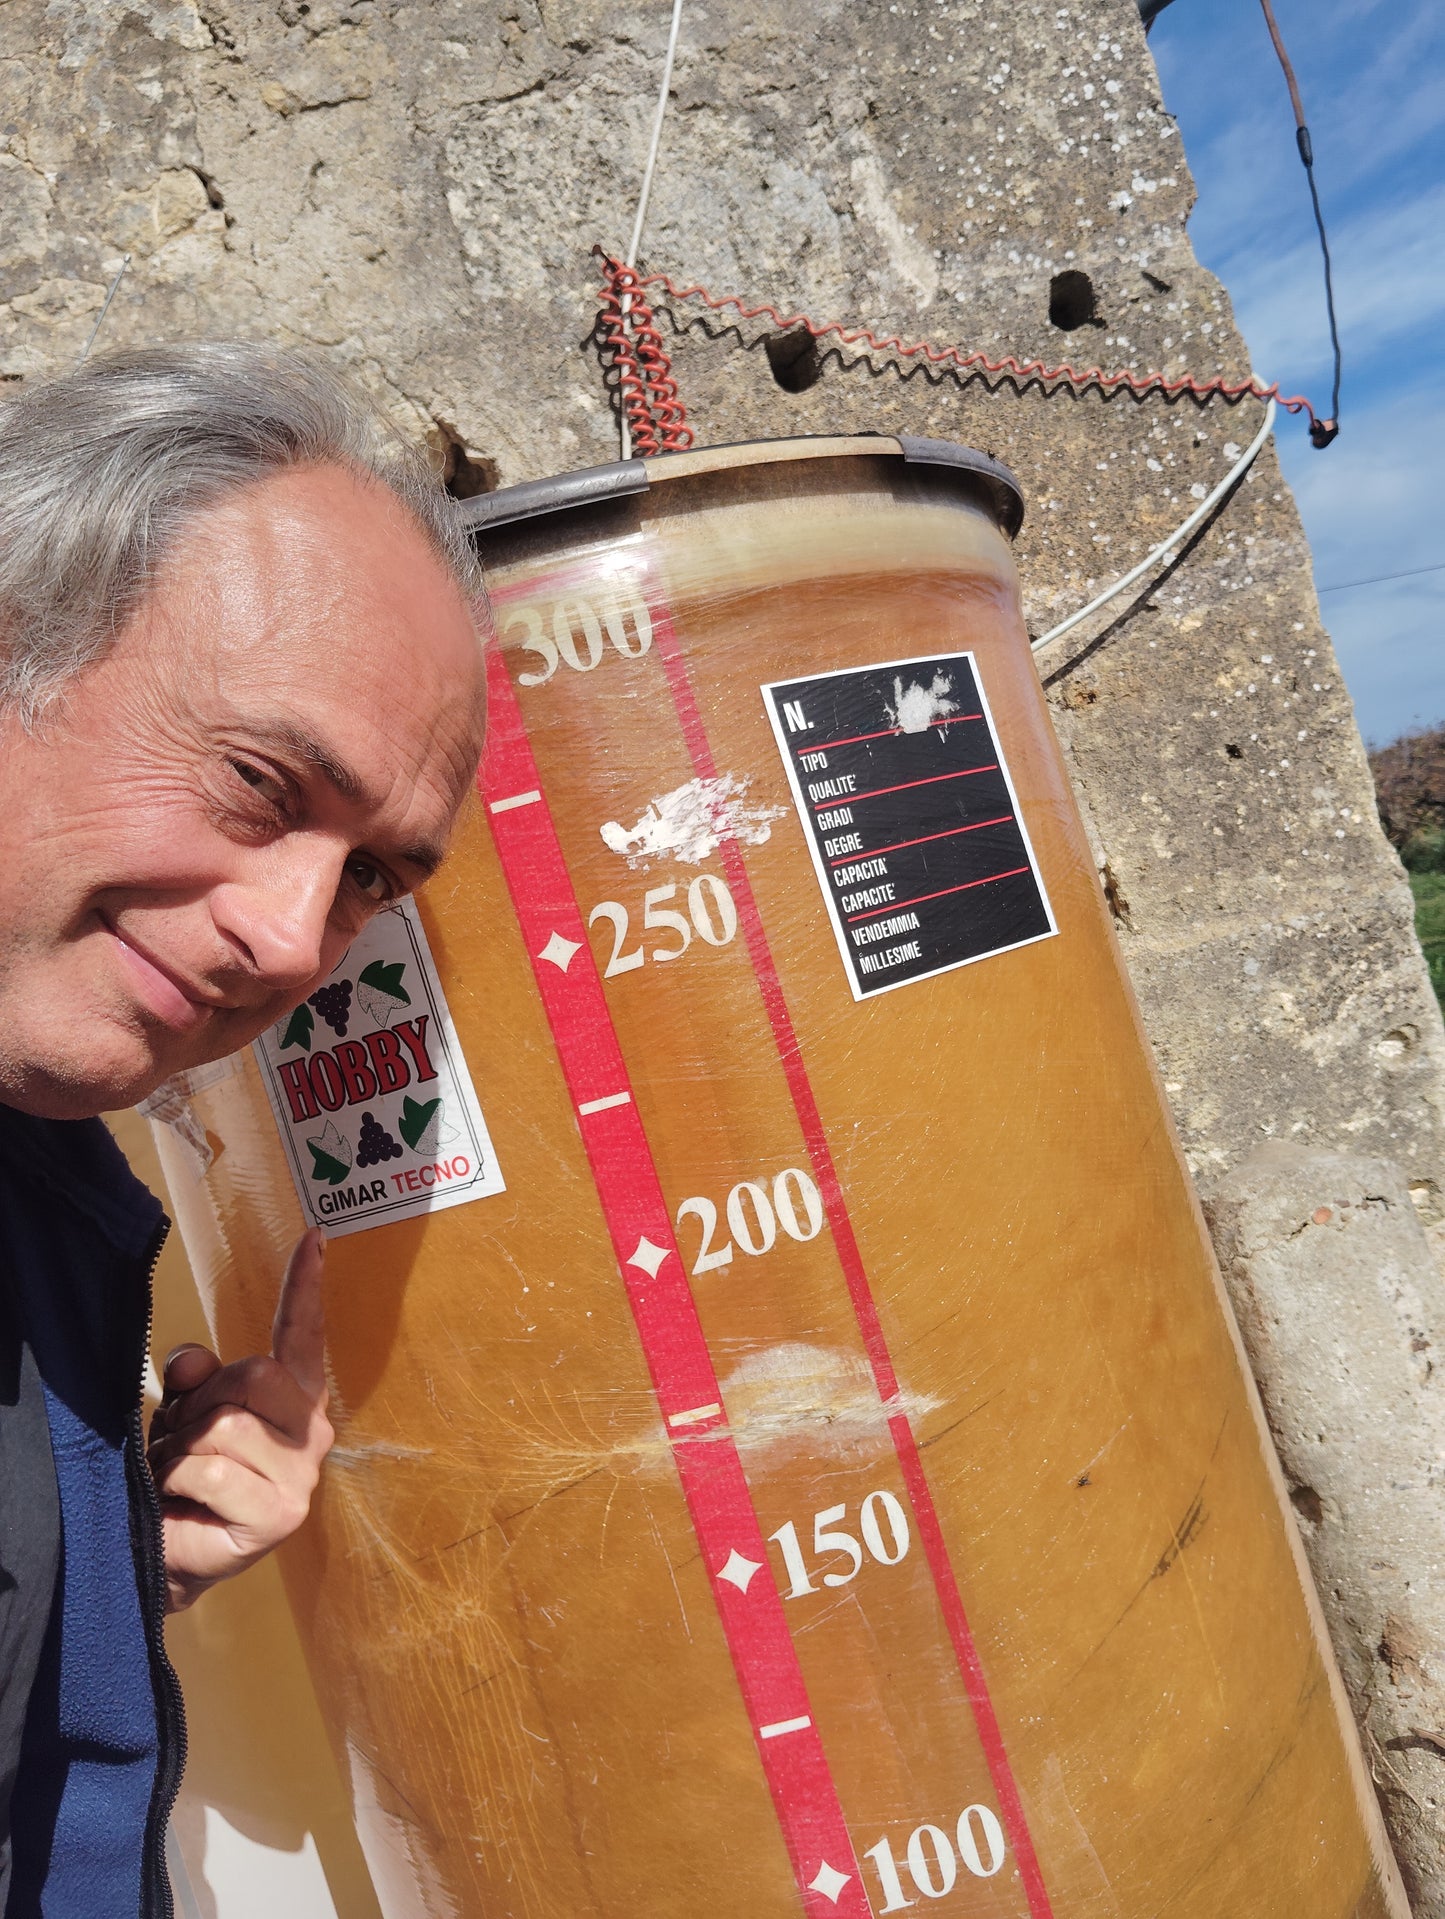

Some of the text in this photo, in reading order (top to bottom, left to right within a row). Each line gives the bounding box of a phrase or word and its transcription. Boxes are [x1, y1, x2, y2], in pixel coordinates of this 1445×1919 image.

[503, 586, 654, 687] 300
[782, 700, 815, 733] N.
[800, 752, 828, 773] TIPO
[808, 774, 857, 802] QUALITE'
[817, 807, 854, 831] GRADI
[824, 832, 864, 857] DEGRE
[833, 858, 888, 887] CAPACITA'
[841, 883, 896, 913] CAPACITE'
[588, 873, 737, 978] 250
[851, 912, 921, 947] VENDEMMIA
[859, 940, 923, 975] MILLESIME
[277, 1015, 439, 1124] HOBBY
[318, 1155, 471, 1215] GIMAR TECNO
[676, 1168, 824, 1276] 200
[768, 1490, 910, 1600] 150
[863, 1804, 1006, 1915] 100
